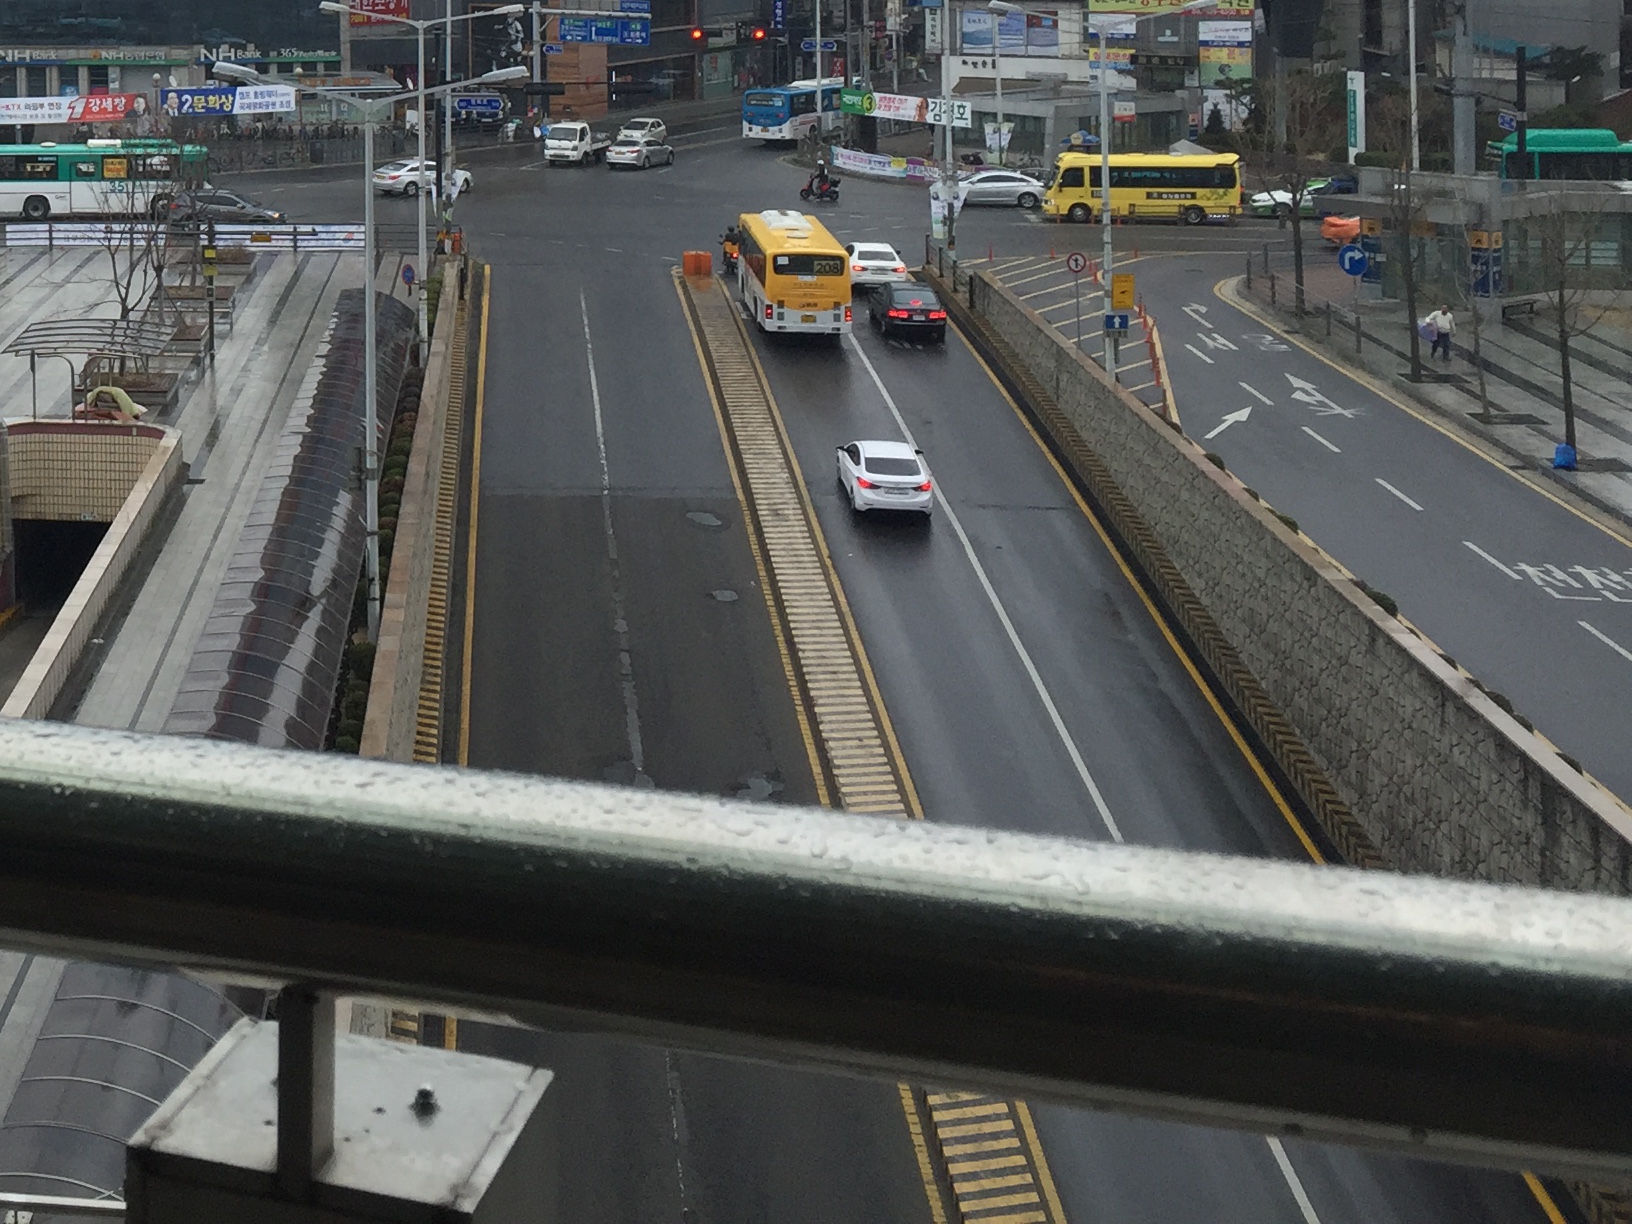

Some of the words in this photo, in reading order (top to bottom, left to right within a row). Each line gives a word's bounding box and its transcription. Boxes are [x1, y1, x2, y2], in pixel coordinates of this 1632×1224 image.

[200, 47, 235, 62] NH
[236, 48, 262, 59] Bank
[88, 96, 127, 112] 강세창
[192, 94, 234, 113] 문희상
[815, 261, 841, 275] 208
